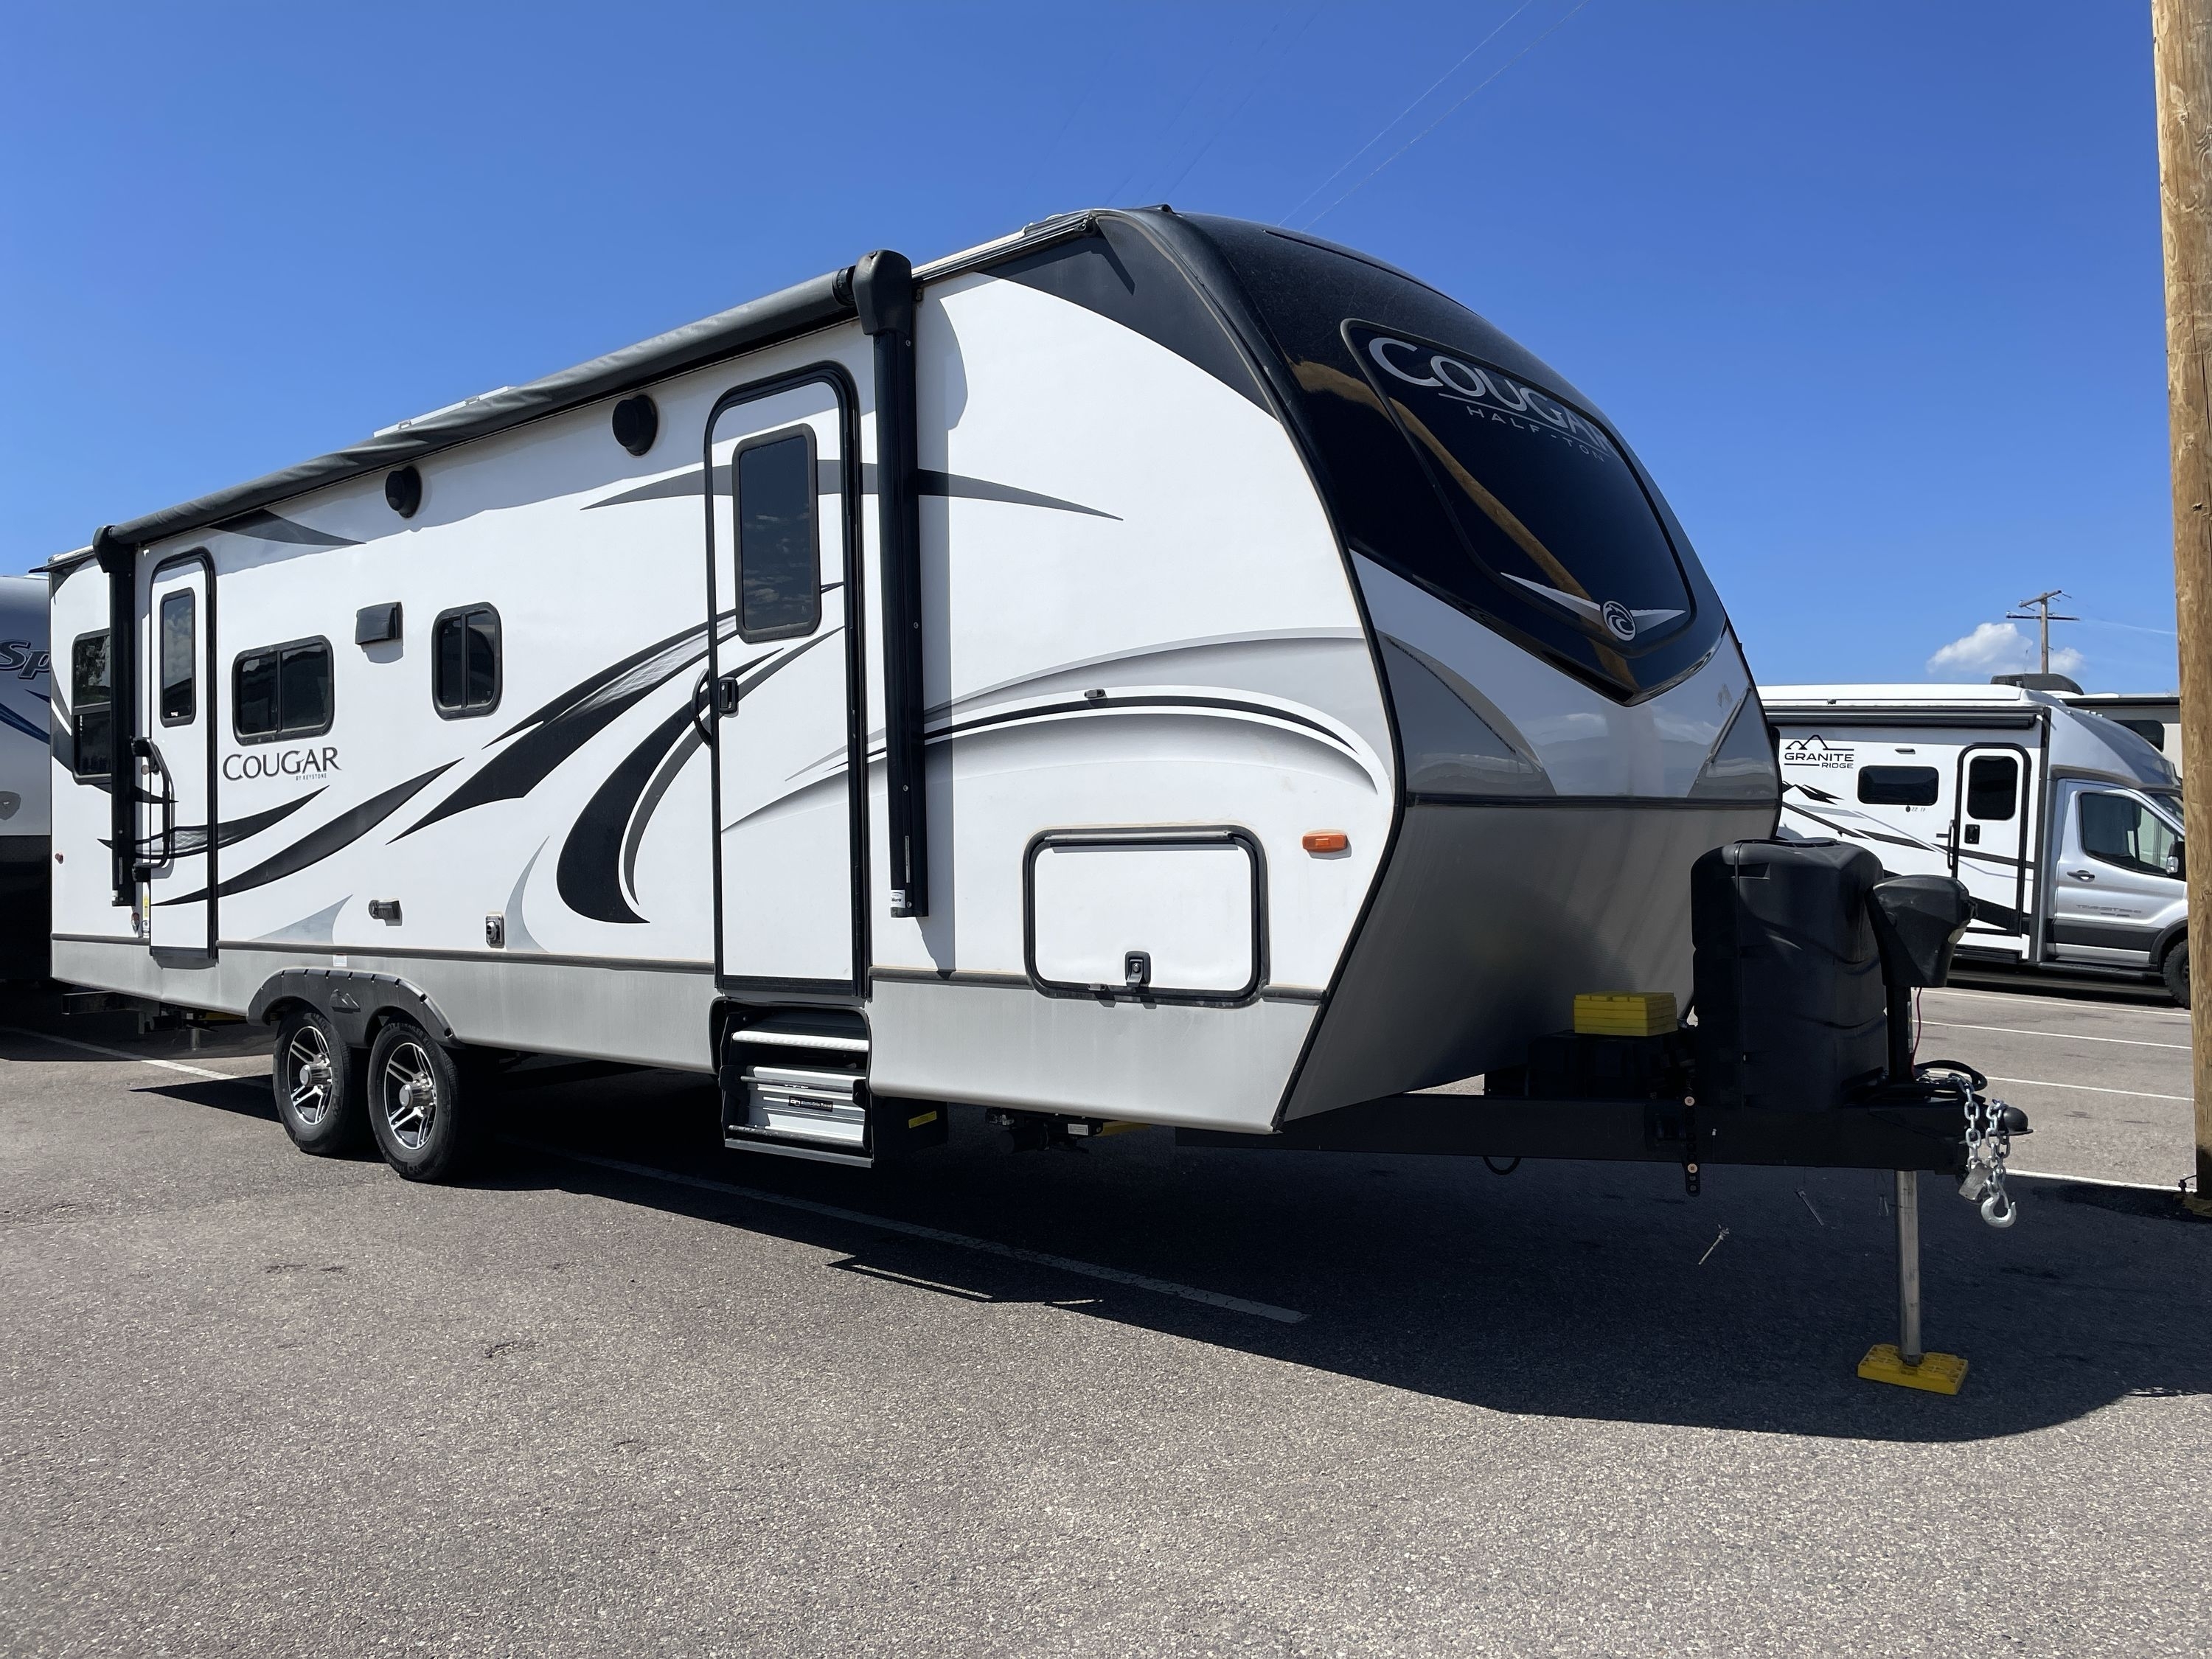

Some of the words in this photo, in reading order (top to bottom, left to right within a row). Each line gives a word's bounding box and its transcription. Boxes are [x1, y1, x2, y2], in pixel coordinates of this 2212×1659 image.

[1368, 337, 1618, 454] COUGAR
[223, 747, 342, 781] COUGAR
[1784, 753, 1854, 762] GRANITE
